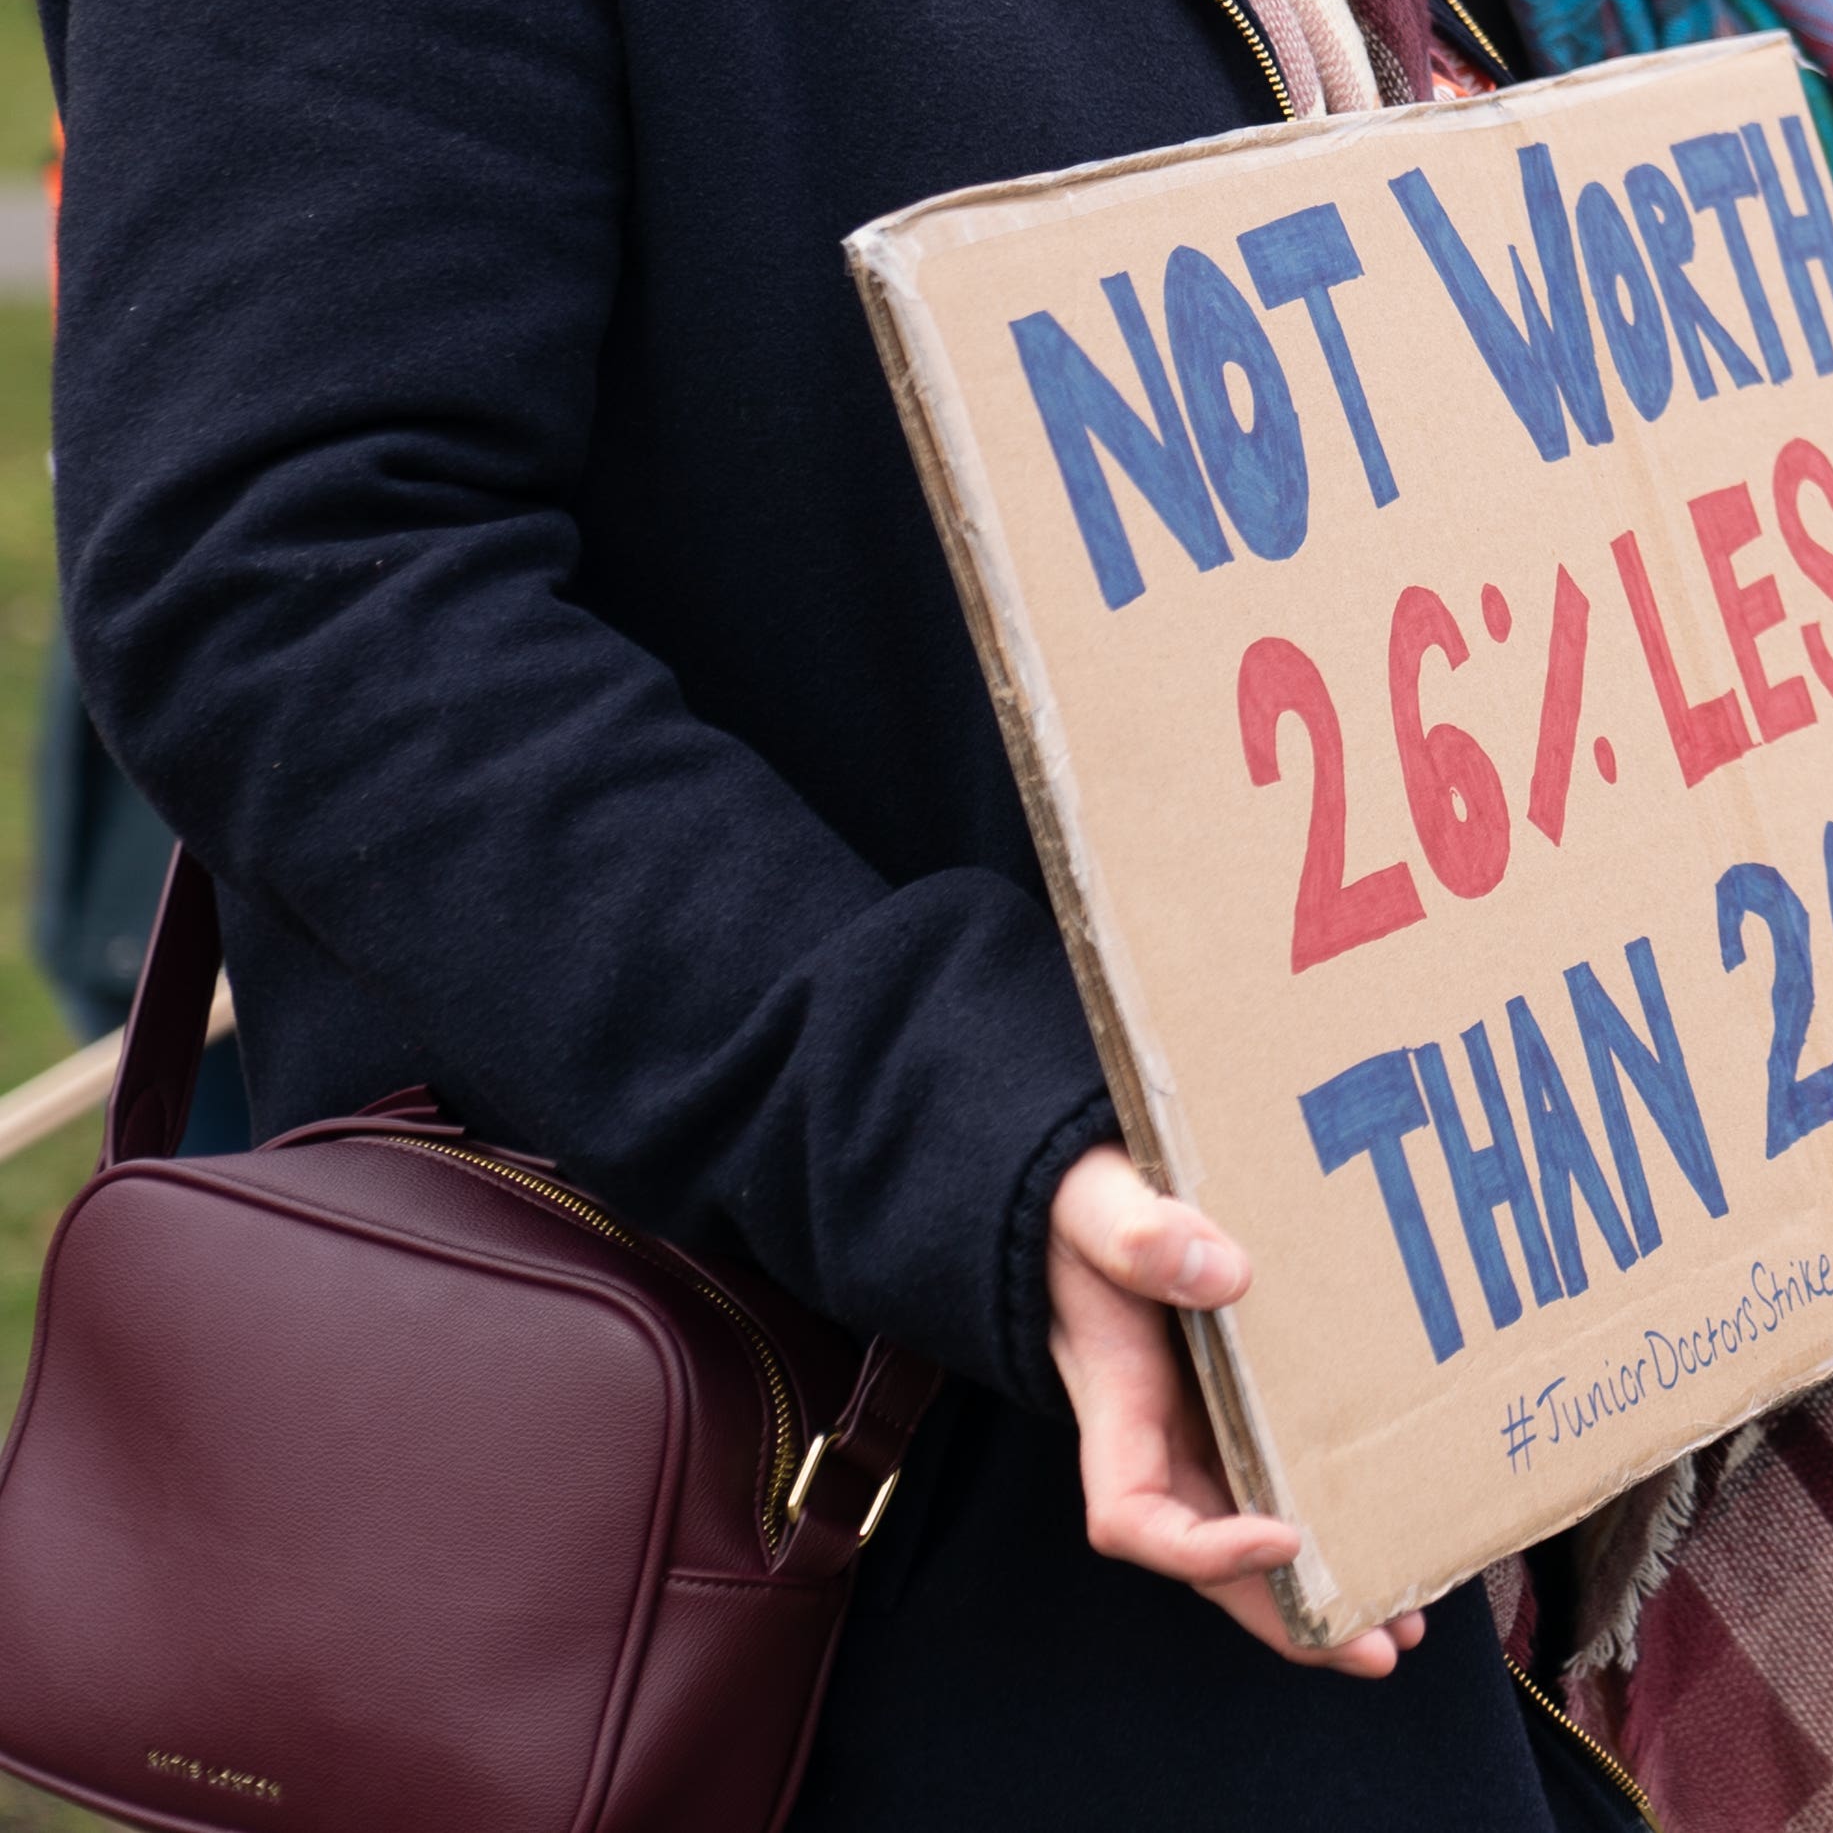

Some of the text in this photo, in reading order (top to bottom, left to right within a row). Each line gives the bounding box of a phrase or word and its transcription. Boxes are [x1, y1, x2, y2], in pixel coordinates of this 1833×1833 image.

[1008, 201, 1400, 612] NOT
[1236, 562, 1618, 974] 26%
[1297, 936, 1730, 1365] THAN
